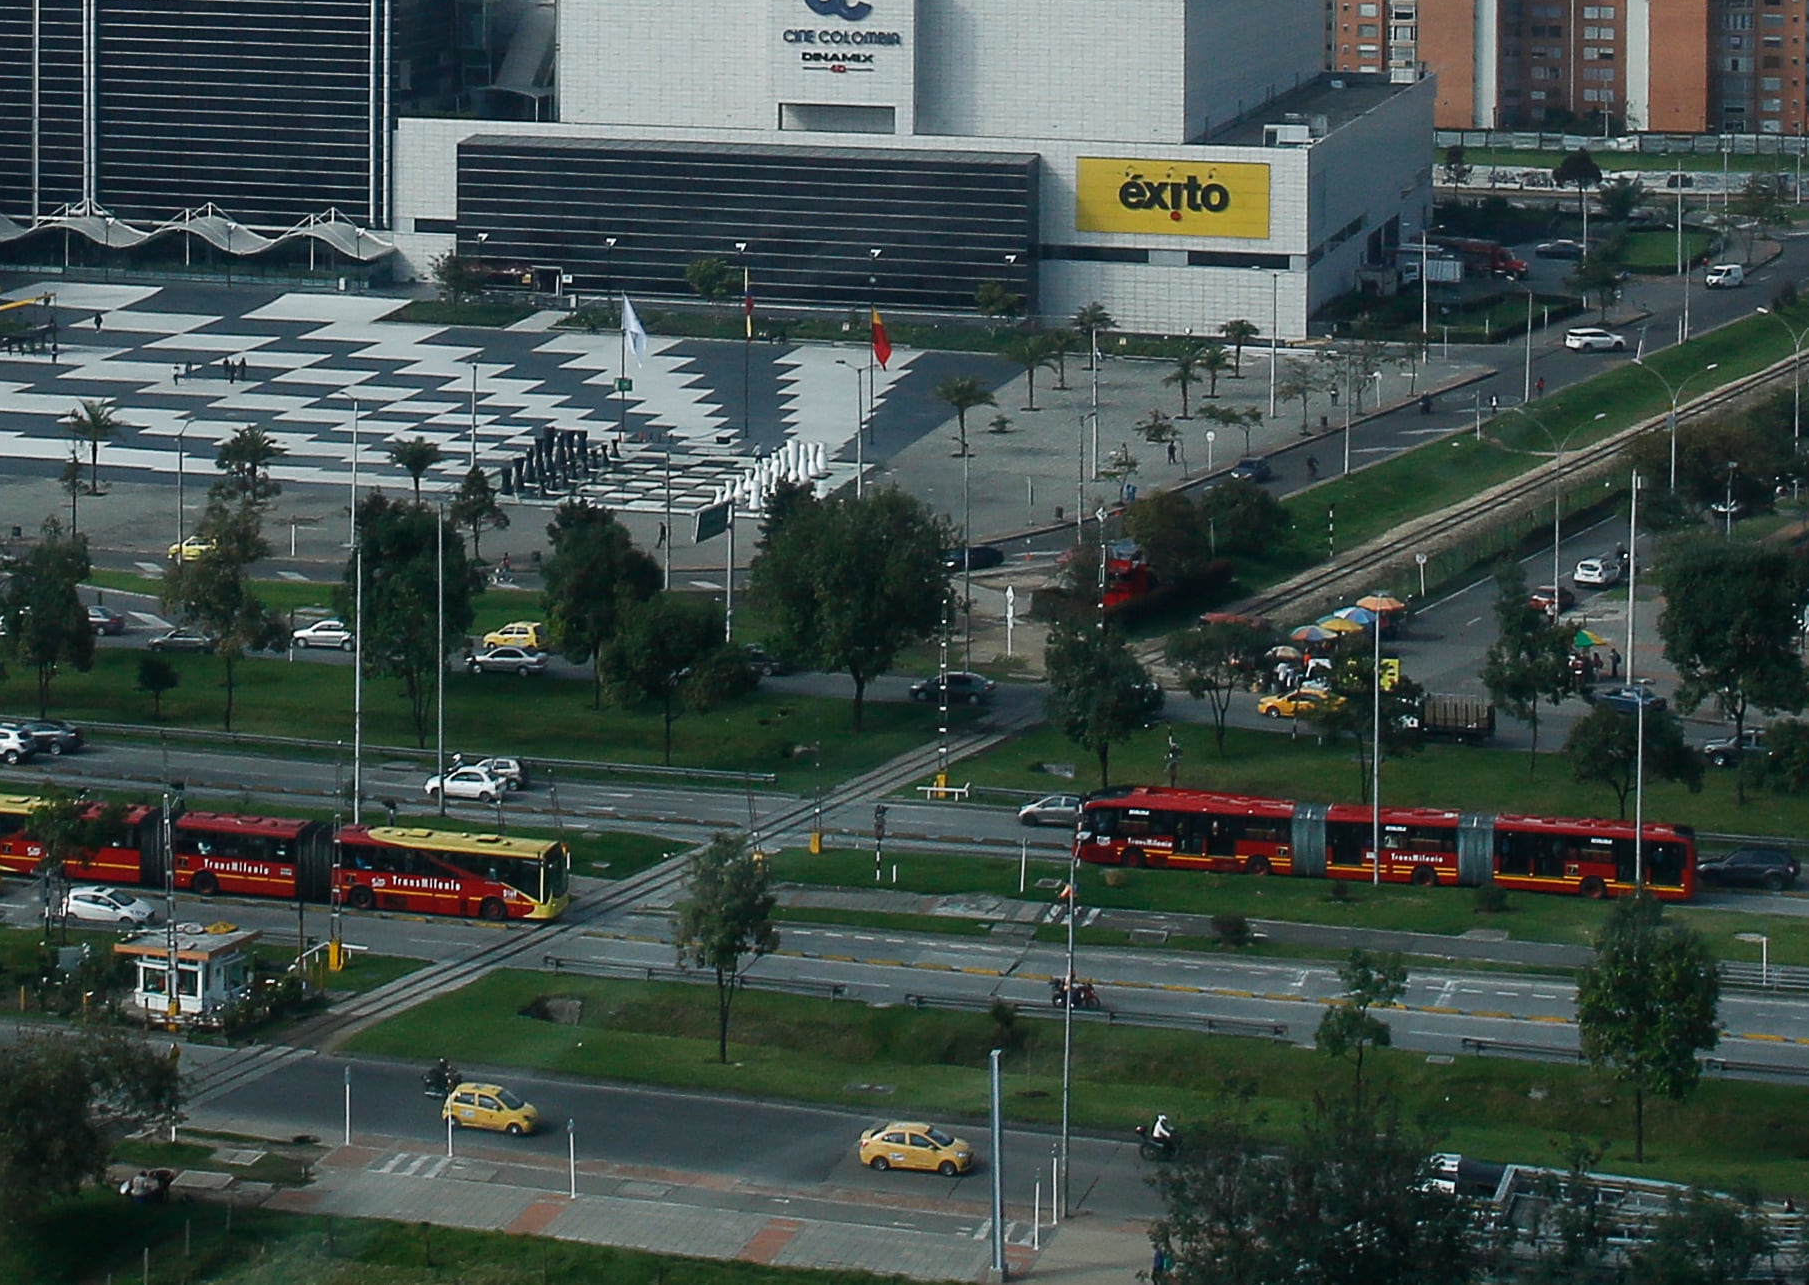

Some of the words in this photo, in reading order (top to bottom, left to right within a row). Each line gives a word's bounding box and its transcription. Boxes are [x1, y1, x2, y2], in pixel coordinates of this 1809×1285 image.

[783, 29, 817, 45] CINE
[818, 30, 901, 46] COLOMBIA
[801, 52, 875, 63] DINAMIX
[1119, 174, 1230, 222] éxito
[204, 858, 270, 875] TransMilenio
[392, 875, 461, 891] TransMilenio
